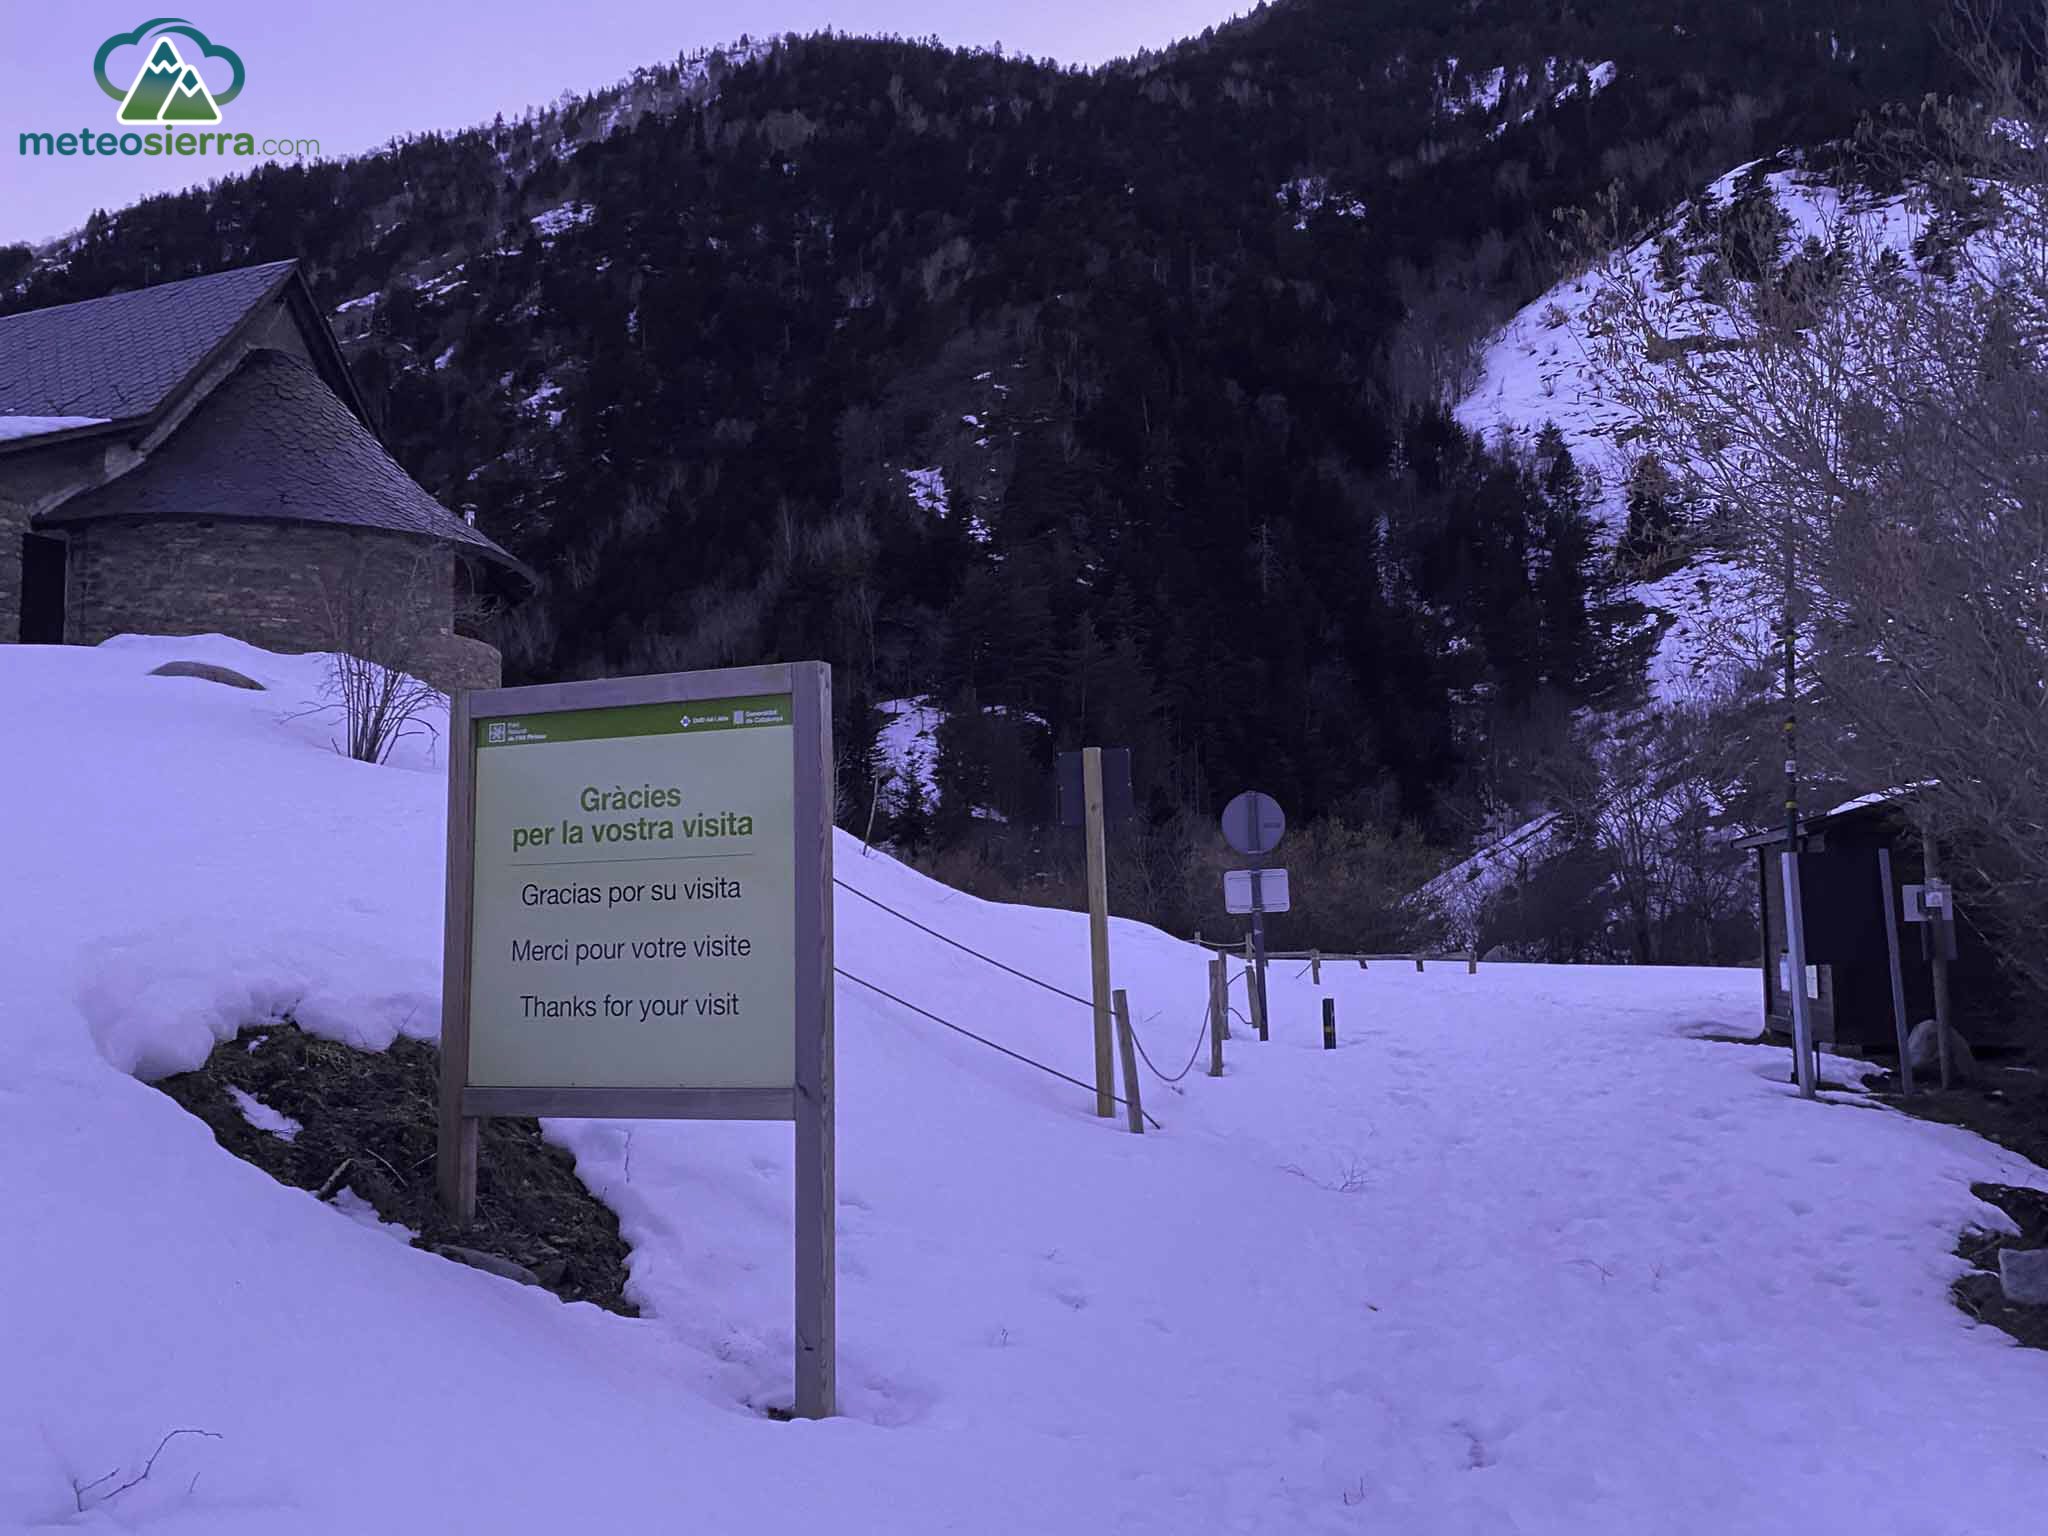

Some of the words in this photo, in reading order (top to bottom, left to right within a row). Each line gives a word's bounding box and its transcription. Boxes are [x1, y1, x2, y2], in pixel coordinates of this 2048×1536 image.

[581, 784, 680, 812] Gràcies
[513, 827, 555, 852] per
[562, 820, 583, 844] la
[592, 818, 673, 843] vostra
[683, 812, 752, 838] visita
[522, 882, 601, 906] Gracias
[609, 885, 645, 909] por
[651, 883, 676, 901] su
[684, 876, 741, 900] visita
[512, 939, 568, 962] Merci
[576, 943, 625, 966] pour
[632, 937, 686, 959] votre
[693, 934, 751, 957] visite
[520, 995, 596, 1017] Thanks
[603, 994, 633, 1016] for
[639, 998, 688, 1022] your
[695, 992, 739, 1015] visit
